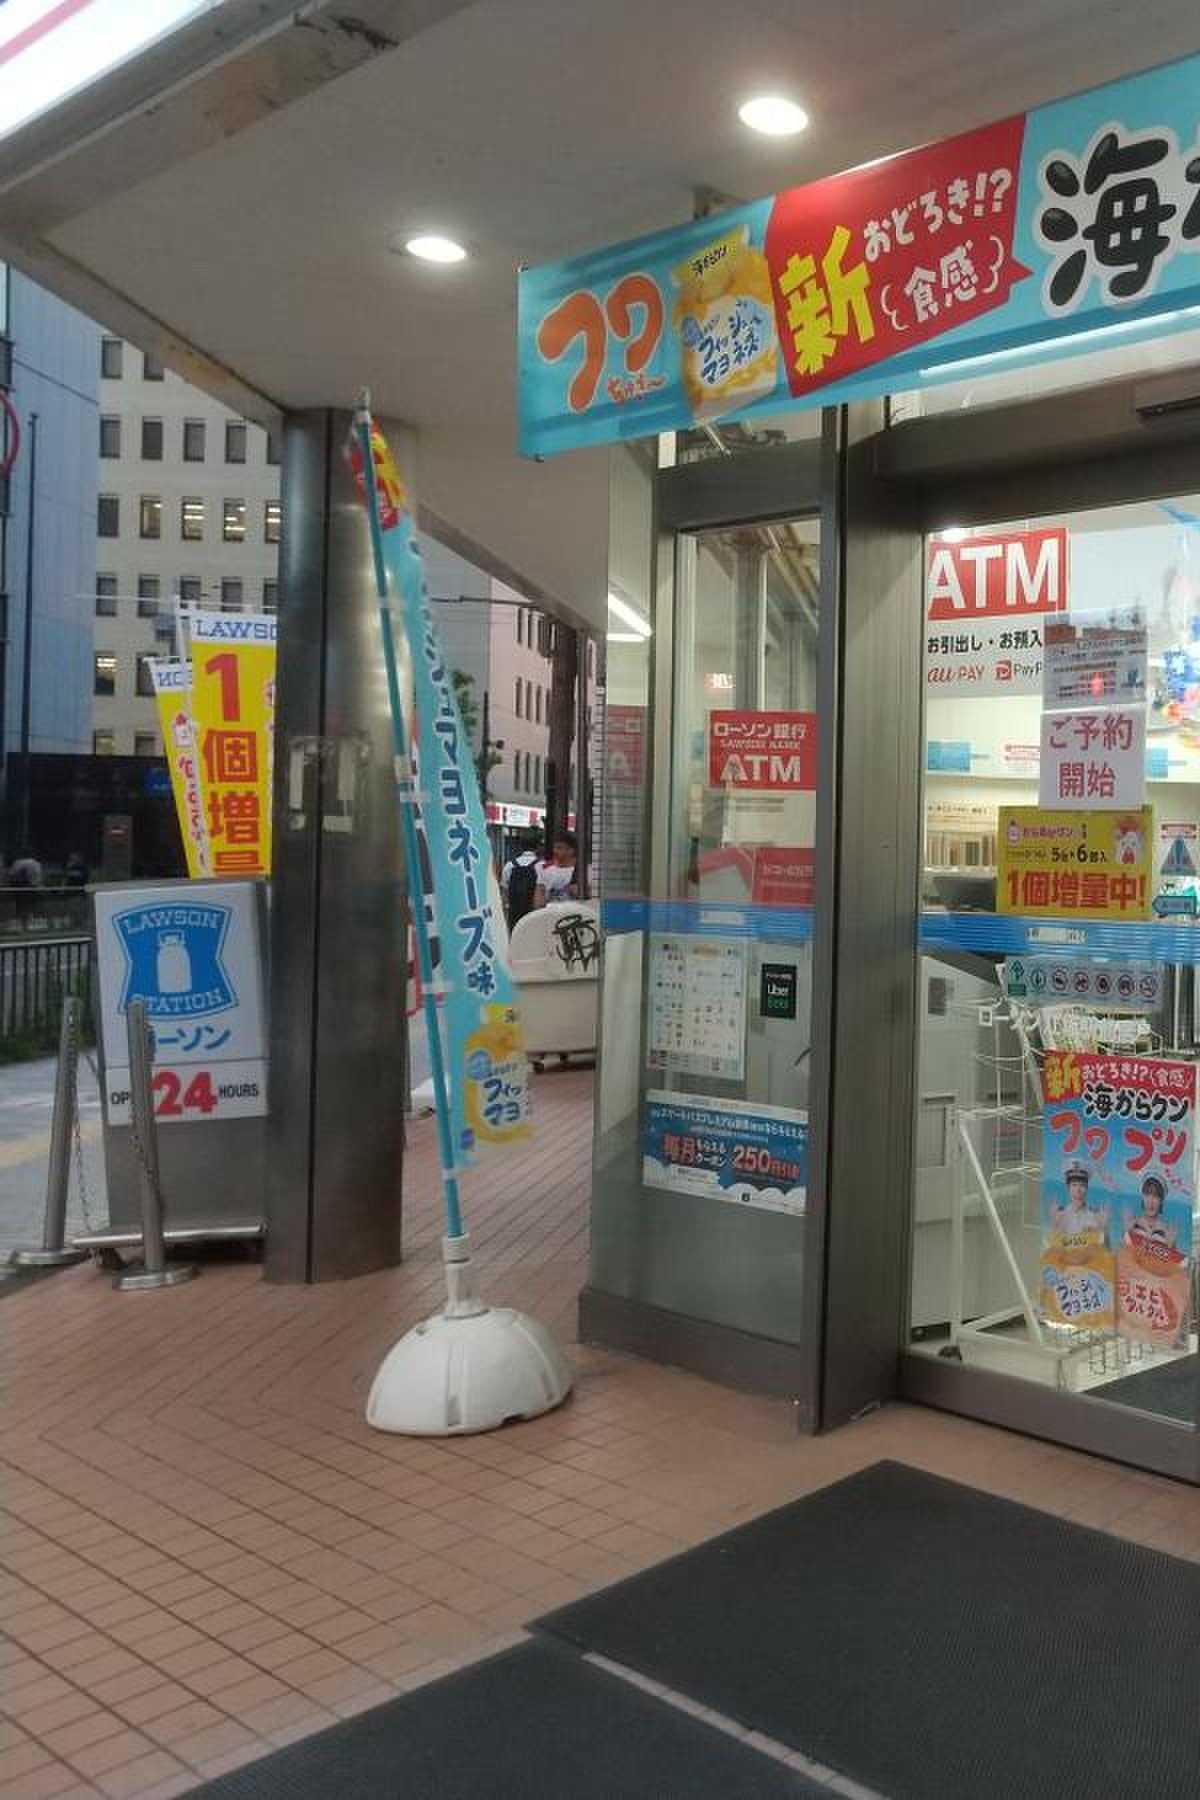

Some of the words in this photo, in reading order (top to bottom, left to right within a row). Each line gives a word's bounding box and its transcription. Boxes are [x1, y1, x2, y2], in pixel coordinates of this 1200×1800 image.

[778, 225, 876, 376] 新
[538, 272, 663, 412] フワ
[928, 537, 1058, 614] ATM
[958, 665, 985, 682] PAY
[1050, 713, 1133, 751] ご予約
[721, 753, 800, 783] ATM
[1059, 761, 1117, 798] 開始
[1008, 870, 1146, 910] 1個増量中!
[124, 910, 221, 934] LAWSON
[150, 1026, 231, 1051] ーソン
[151, 1071, 218, 1116] 24
[218, 1083, 259, 1099] HOURS
[1045, 1055, 1081, 1099] 新
[1084, 1081, 1189, 1123] 海からクン
[1050, 1112, 1109, 1160] フワ
